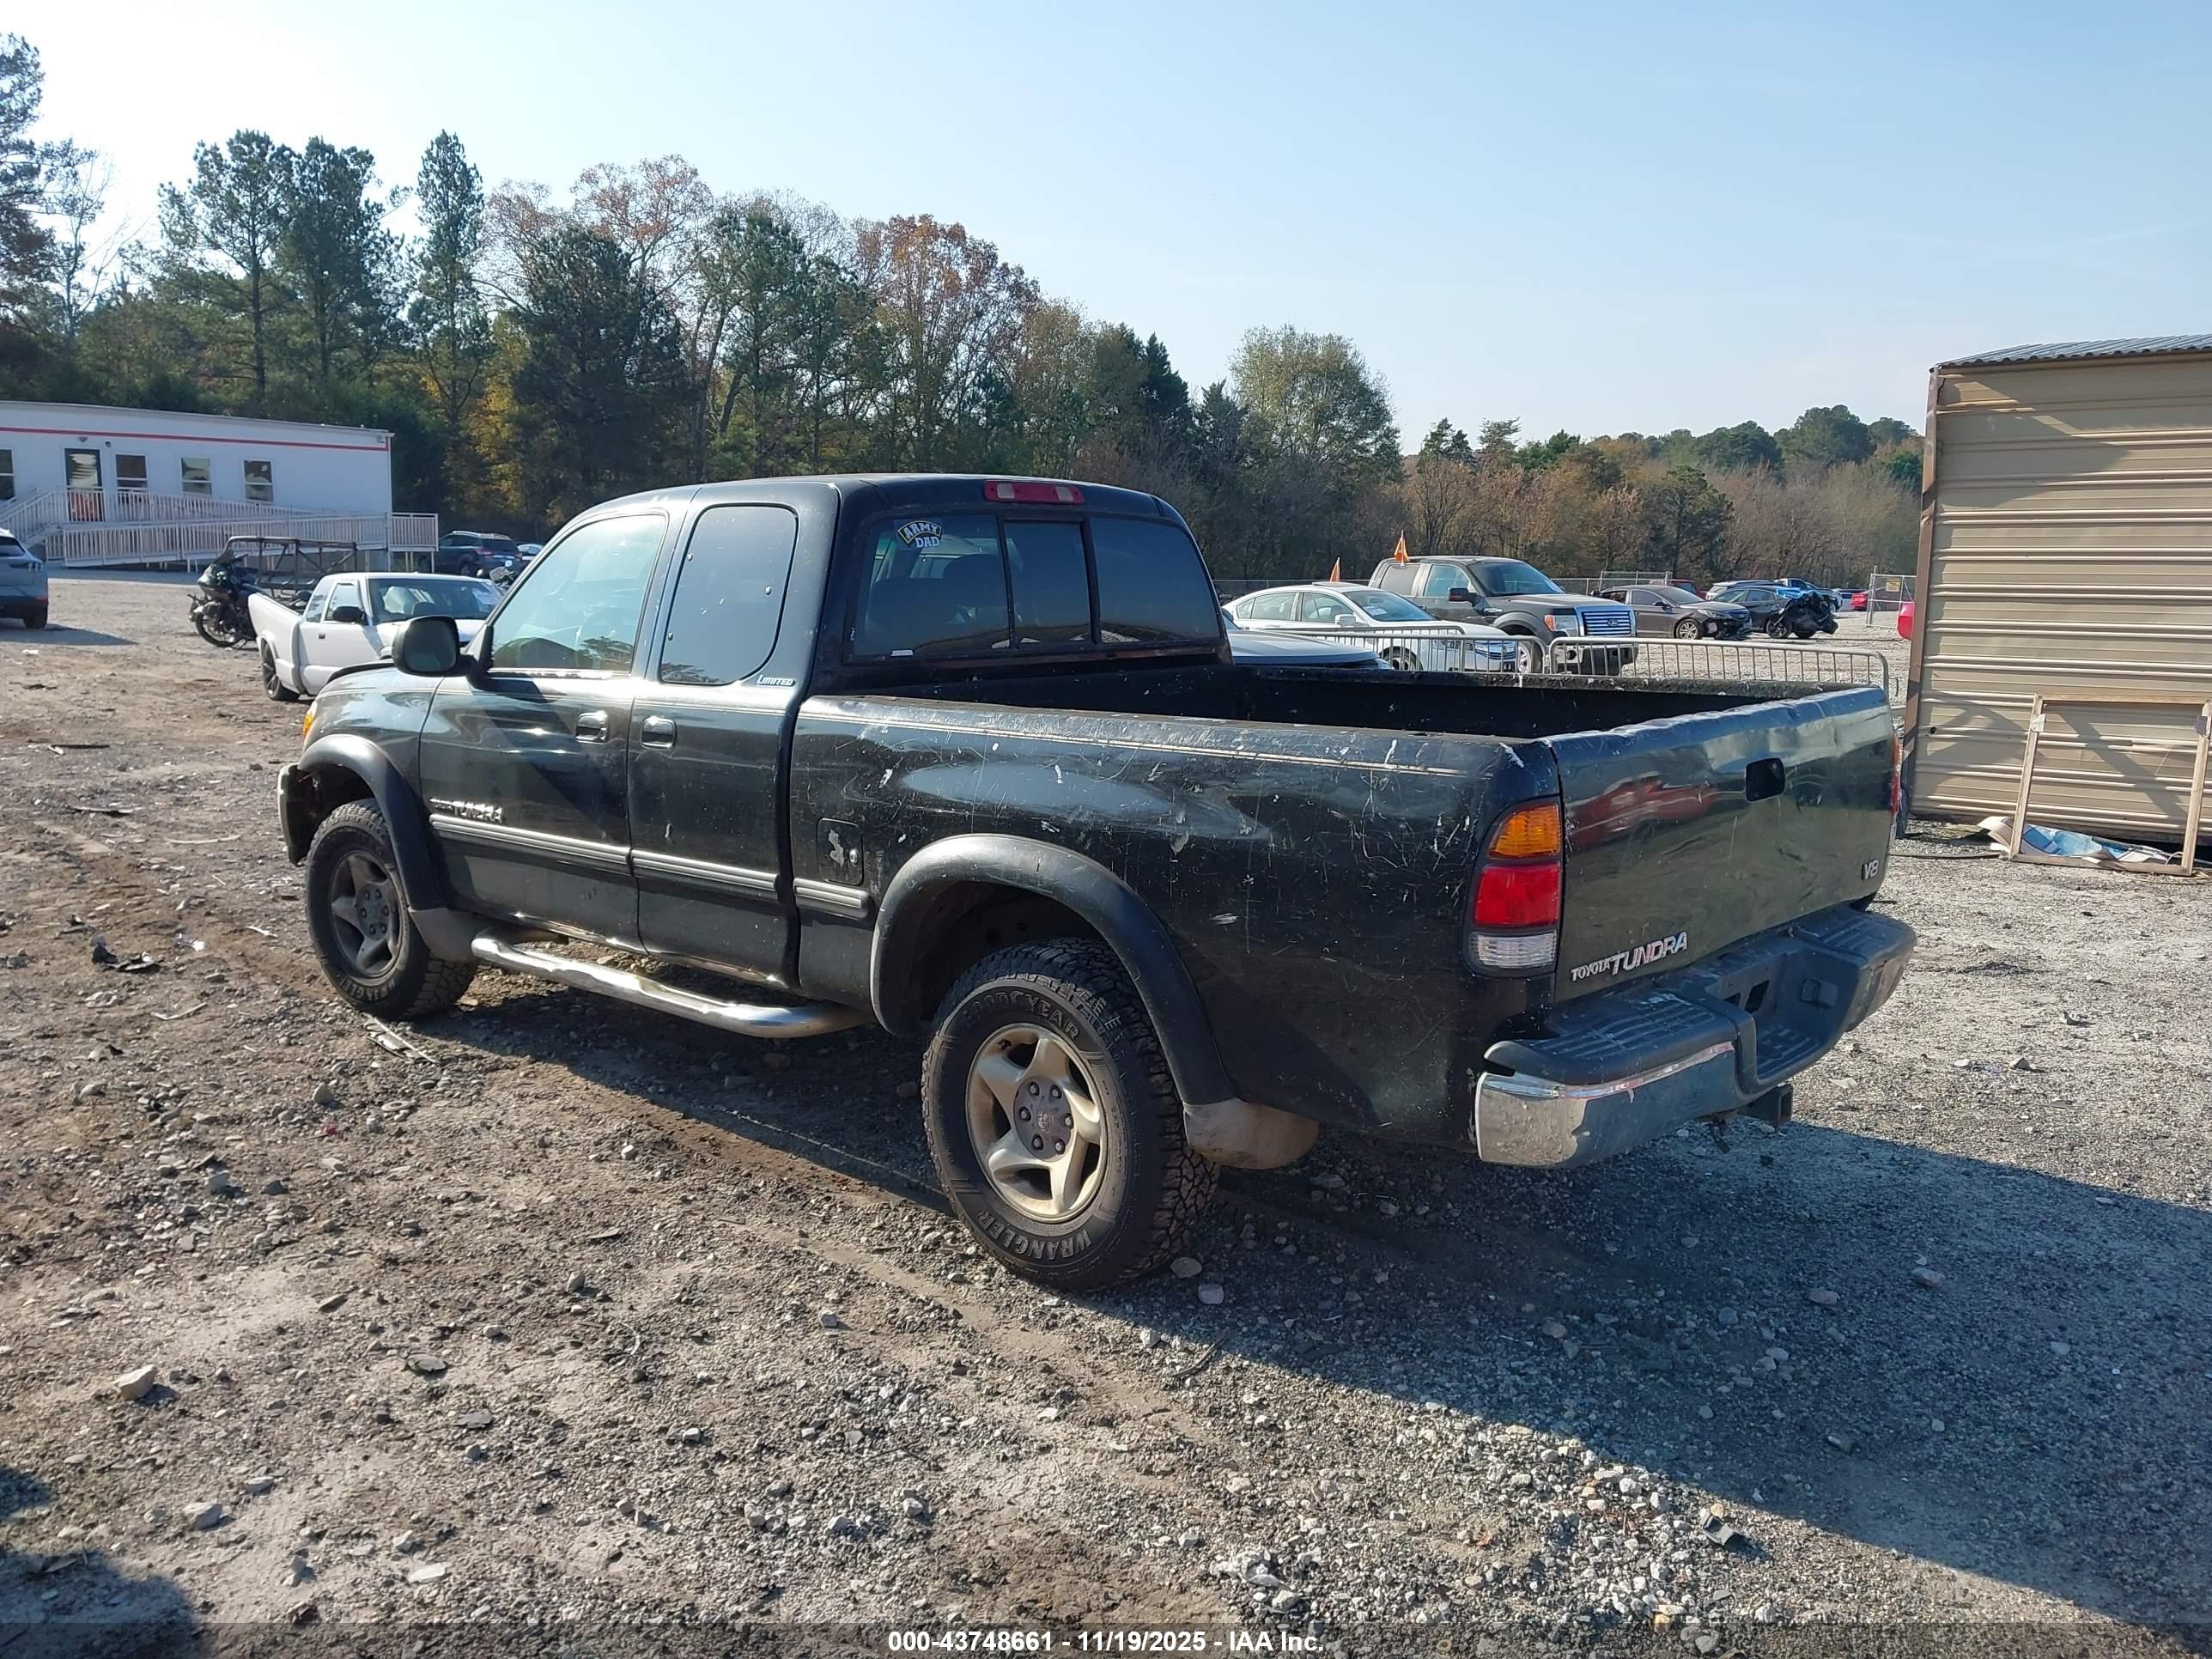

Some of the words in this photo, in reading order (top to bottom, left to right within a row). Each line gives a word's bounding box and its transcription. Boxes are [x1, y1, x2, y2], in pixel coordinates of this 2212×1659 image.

[902, 522, 938, 539] ARMY
[915, 536, 940, 548] DAD
[1862, 859, 1879, 880] V8
[1571, 957, 1611, 981] TOYOTA
[1608, 932, 1688, 975] TUNDRA
[975, 1208, 1093, 1261] WRANGLER
